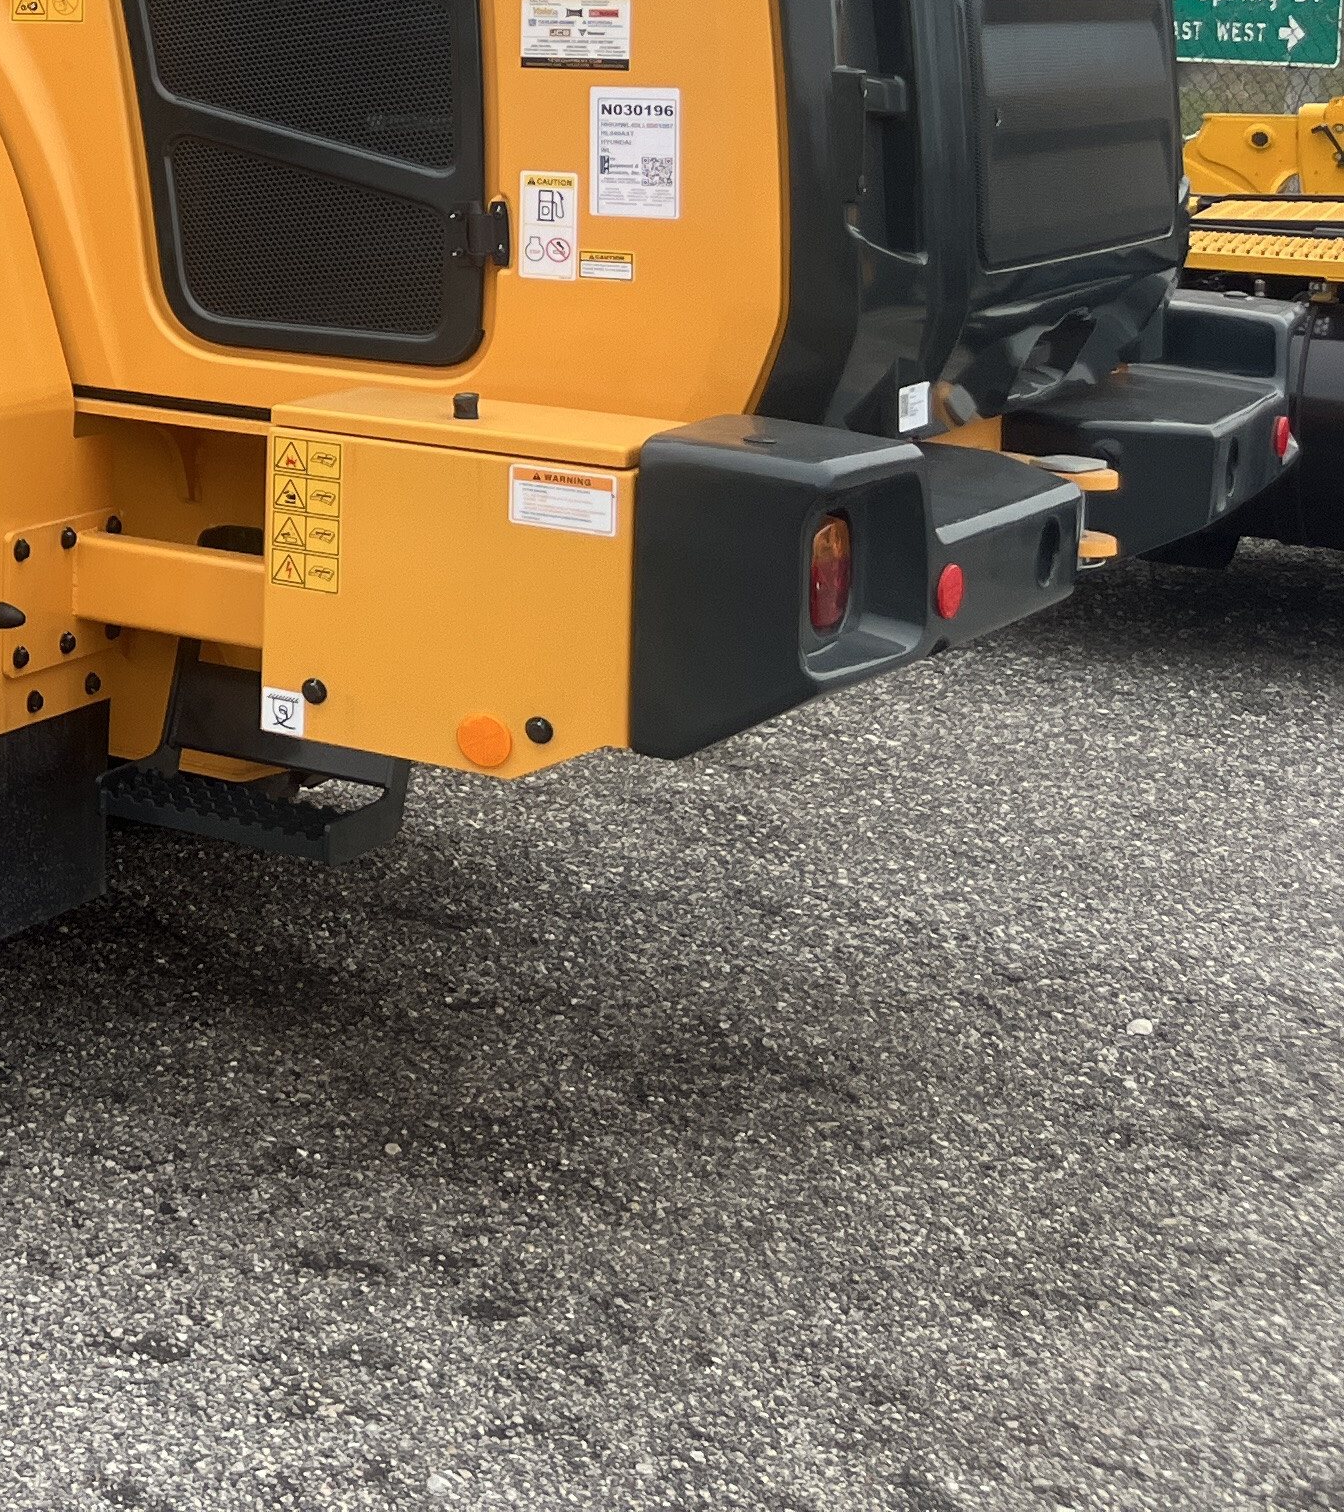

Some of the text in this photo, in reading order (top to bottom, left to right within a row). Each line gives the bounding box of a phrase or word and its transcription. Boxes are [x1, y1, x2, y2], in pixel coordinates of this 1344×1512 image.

[1216, 21, 1267, 42] WEST
[601, 104, 674, 116] N030196
[537, 178, 572, 186] CAUTION
[544, 474, 591, 486] WARNING
